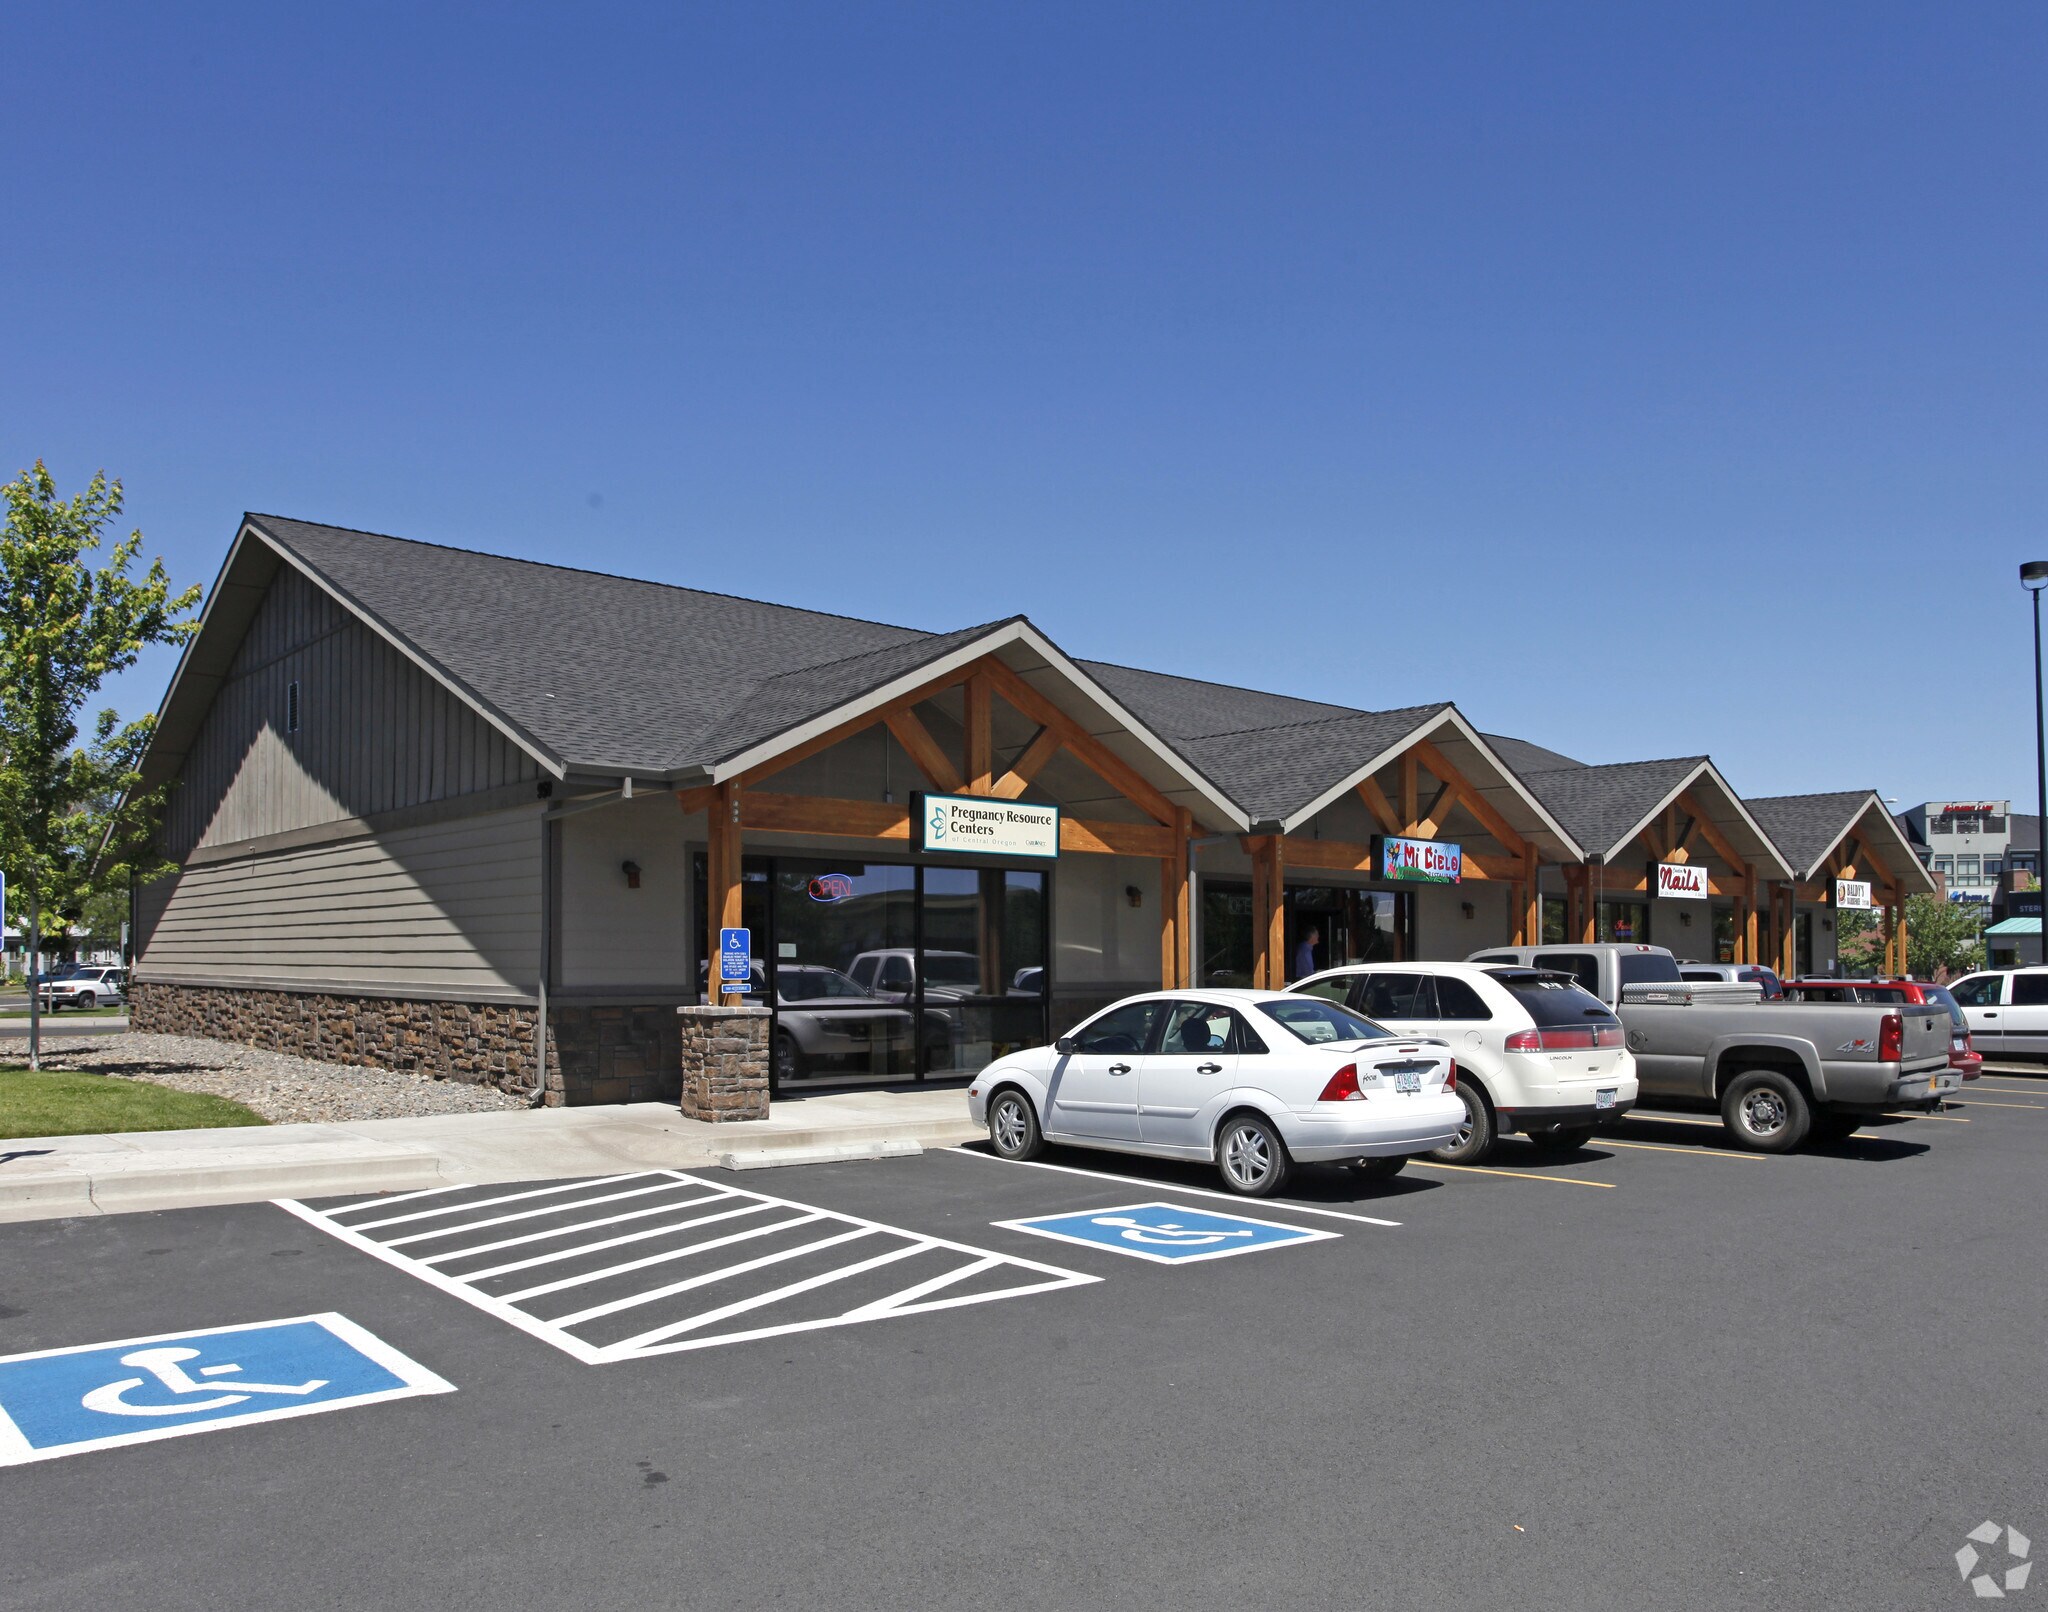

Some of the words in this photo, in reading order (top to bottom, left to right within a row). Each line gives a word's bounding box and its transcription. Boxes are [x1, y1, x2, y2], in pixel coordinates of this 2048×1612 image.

[951, 805, 1005, 825] Pregnancy
[1006, 810, 1052, 826] Resource
[950, 821, 994, 836] Centers
[963, 836, 989, 845] Central
[993, 839, 1017, 848] Oregon
[1660, 866, 1700, 891] Nails
[808, 879, 852, 897] OPEN
